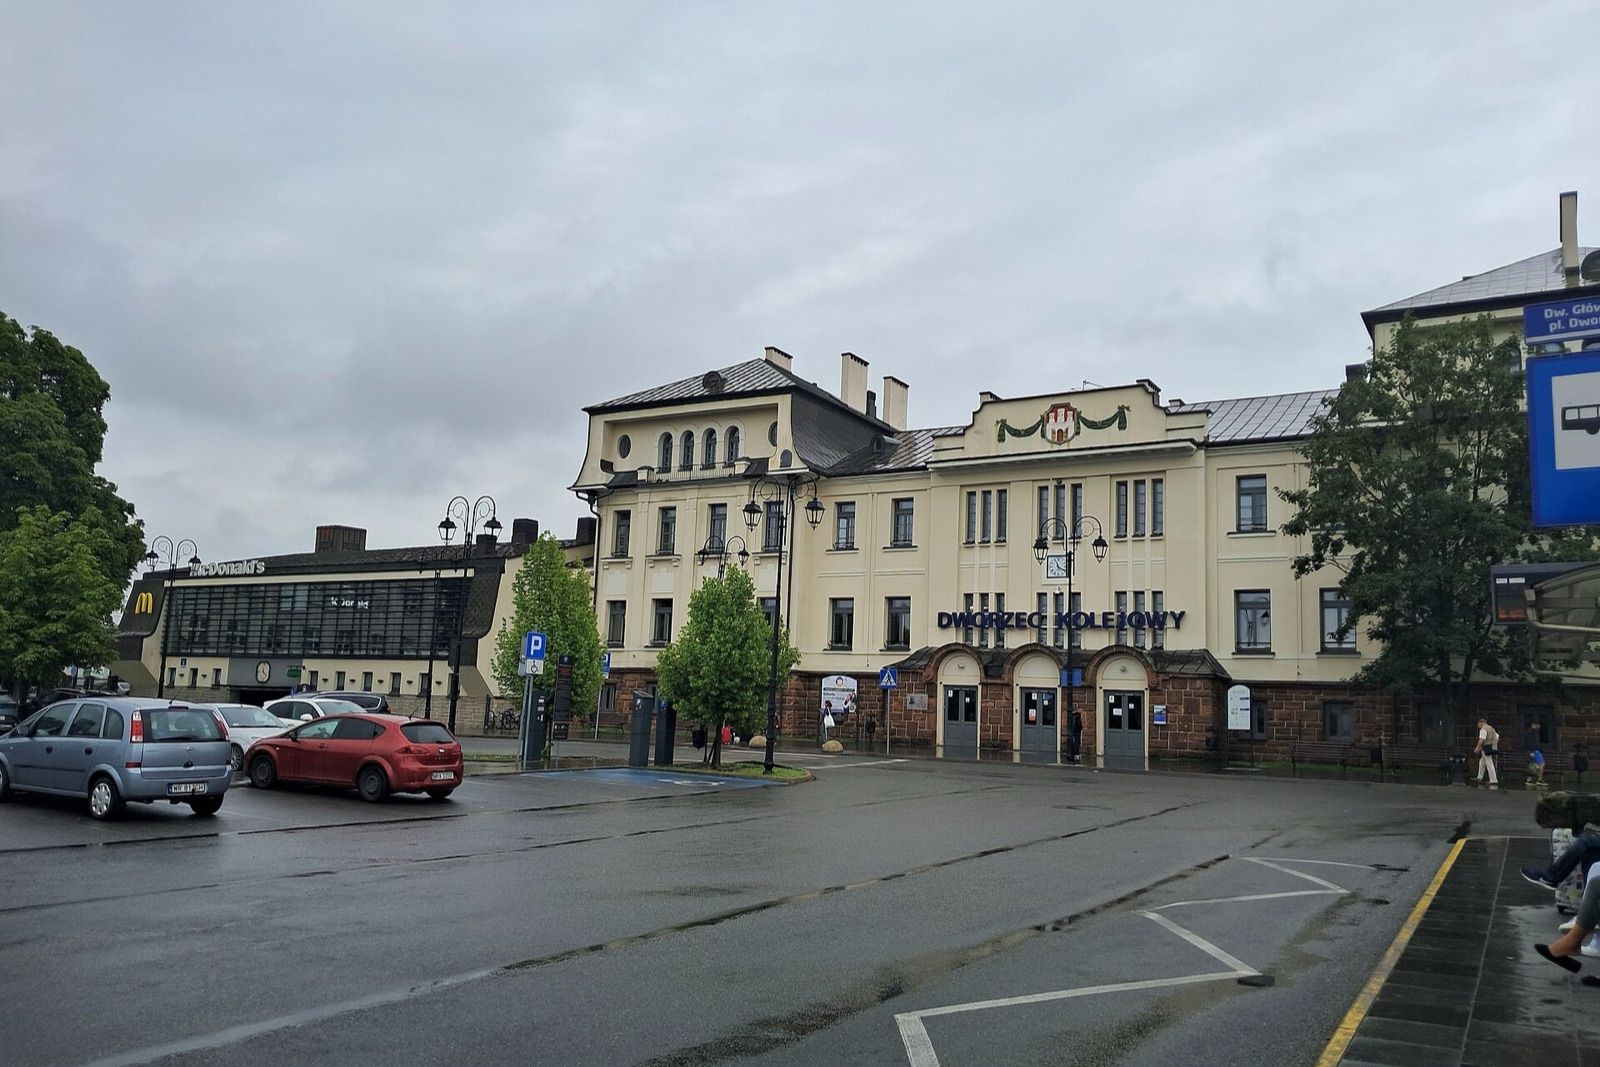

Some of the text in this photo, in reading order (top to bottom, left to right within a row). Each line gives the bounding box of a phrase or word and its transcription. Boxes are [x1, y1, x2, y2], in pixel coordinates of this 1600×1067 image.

[1544, 308, 1569, 319] Dw.
[1549, 317, 1600, 333] pl. Dwo
[937, 611, 1186, 630] DWORZEC KOLEJOWY
[530, 635, 542, 656] P
